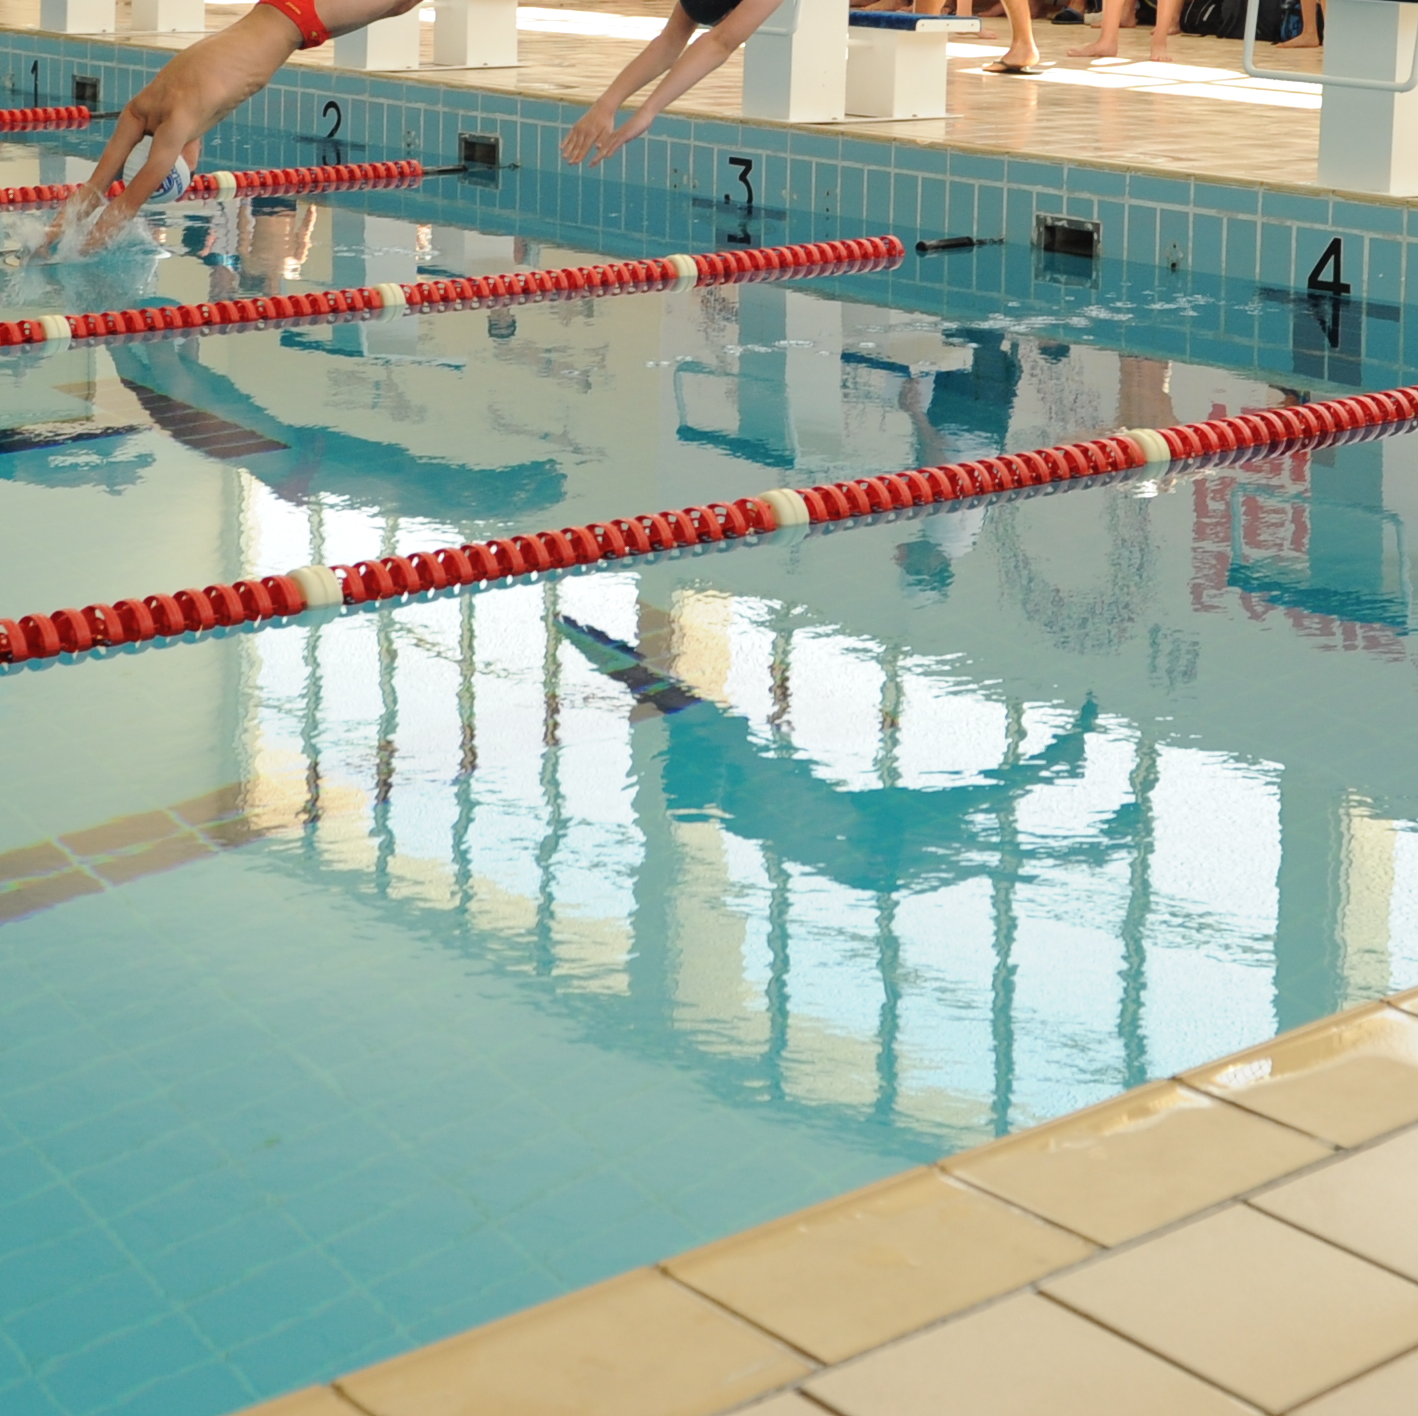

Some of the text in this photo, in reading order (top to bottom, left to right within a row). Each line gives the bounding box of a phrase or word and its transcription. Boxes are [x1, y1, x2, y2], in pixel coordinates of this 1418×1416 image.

[30, 59, 39, 99] 1
[322, 100, 342, 140] 2
[723, 156, 754, 205] 3
[1306, 236, 1352, 297] 4
